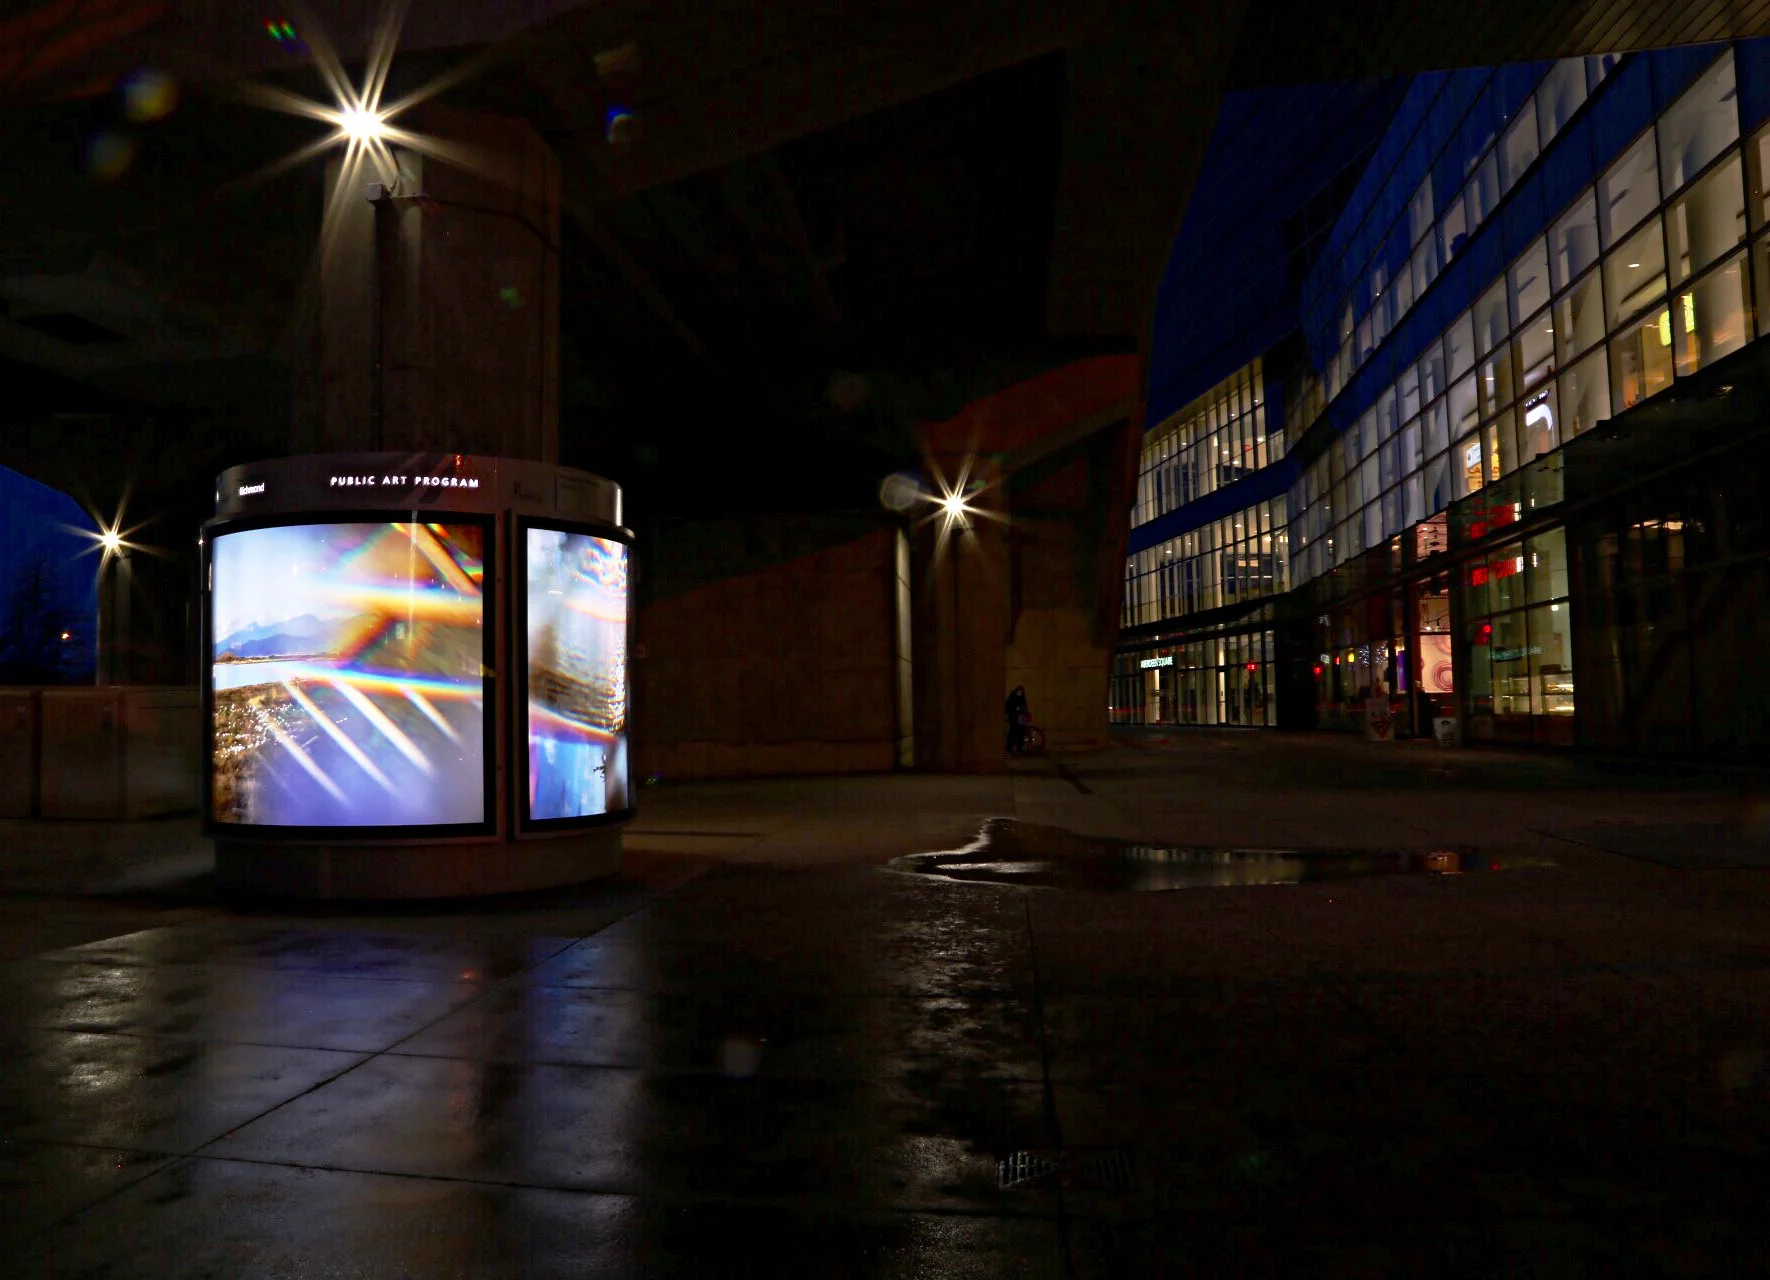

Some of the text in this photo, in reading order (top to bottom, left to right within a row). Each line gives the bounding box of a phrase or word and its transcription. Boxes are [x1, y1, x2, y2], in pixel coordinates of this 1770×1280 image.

[330, 475, 479, 488] PUBLIC ART PROGRAM
